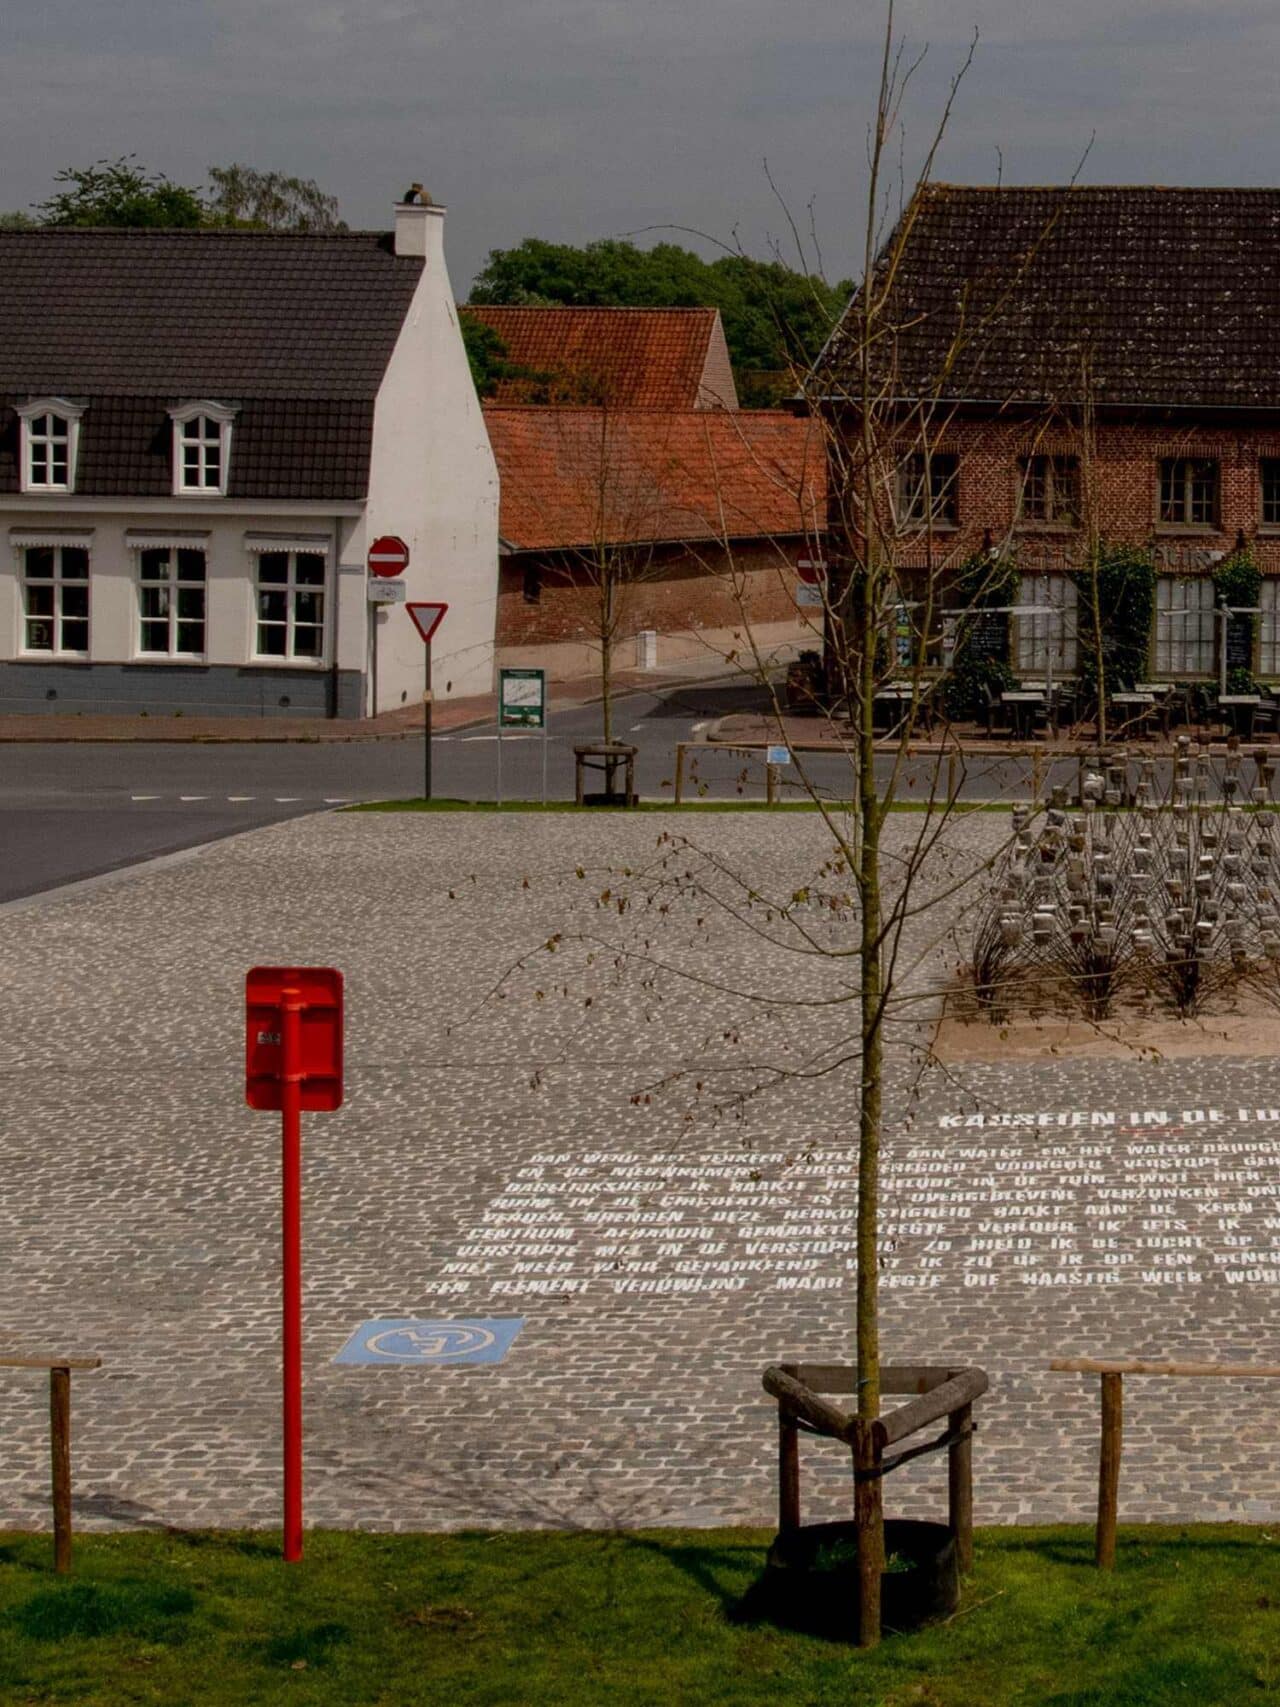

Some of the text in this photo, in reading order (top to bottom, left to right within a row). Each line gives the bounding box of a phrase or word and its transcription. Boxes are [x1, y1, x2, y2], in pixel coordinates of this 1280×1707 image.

[939, 1112, 1116, 1129] KASSEIEN
[1131, 1111, 1168, 1126] IN
[1183, 1109, 1222, 1124] DE
[531, 1154, 570, 1164] DAN
[583, 1154, 639, 1163] WERD
[700, 1153, 784, 1163] VERKEER
[906, 1149, 946, 1159] AAN
[959, 1148, 1023, 1158] WATER
[1041, 1147, 1068, 1156] EN
[1080, 1146, 1112, 1156] HET
[1127, 1144, 1190, 1155] WATER
[517, 1167, 545, 1177] EN
[564, 1167, 591, 1177] DE
[995, 1160, 1102, 1171] VOORGOED
[1124, 1157, 1220, 1168] VERSTOPT
[505, 1181, 665, 1193] DAGELIJKSHEID
[689, 1182, 711, 1191] IK
[972, 1177, 994, 1187] IN
[1014, 1177, 1039, 1186] DE
[1058, 1175, 1105, 1186] TUIN
[1125, 1173, 1187, 1184] KWIJT
[1214, 1171, 1260, 1182] HIER
[569, 1197, 596, 1207] IN
[614, 1197, 640, 1206] DE
[812, 1195, 832, 1205] IS
[911, 1190, 1077, 1203] OVERGEBLEVENE
[1098, 1187, 1220, 1199] VERZONKEN
[482, 1211, 565, 1222] VERDER
[584, 1211, 685, 1222] BRENGEN
[712, 1211, 763, 1221] DEZE
[784, 1204, 972, 1219] HERKOSTIGHEID
[1085, 1204, 1128, 1215] AAN
[1150, 1204, 1176, 1214] DE
[1197, 1202, 1254, 1213] KERN
[467, 1227, 575, 1239] CENTRUM
[604, 1227, 715, 1239] AFHANDIG
[738, 1224, 855, 1237] GEMAAKTE
[877, 1222, 947, 1234] LEEGTE
[978, 1221, 1074, 1233] VERLOOR
[1098, 1220, 1120, 1231] IK
[1142, 1219, 1187, 1231] IETS
[1218, 1219, 1241, 1230] IK
[456, 1244, 578, 1257] VERSTOPTE
[657, 1243, 684, 1255] IN
[699, 1243, 729, 1254] DE
[924, 1240, 953, 1252] ZO
[971, 1239, 1032, 1250] HIELD
[1051, 1238, 1073, 1249] IK
[1092, 1237, 1119, 1248] DE
[1135, 1236, 1203, 1248] LUCHT
[1223, 1235, 1252, 1246] OP
[440, 1262, 492, 1274] NIET
[511, 1262, 574, 1273] MEER
[674, 1258, 820, 1272] GEPARKEERD
[920, 1257, 944, 1268] IK
[963, 1256, 993, 1267] ZO
[1013, 1255, 1041, 1266] OF
[1061, 1254, 1084, 1265] IK
[1103, 1253, 1135, 1265] OP
[1152, 1254, 1195, 1265] EEN
[425, 1280, 472, 1293] EEN
[490, 1280, 591, 1293] ELEMENT
[612, 1278, 750, 1292] VERDWIJNT
[776, 1276, 844, 1290] MAAR
[963, 1273, 1001, 1286] DIE
[1022, 1271, 1121, 1285] HAASTIG
[1141, 1271, 1203, 1284] WEER
